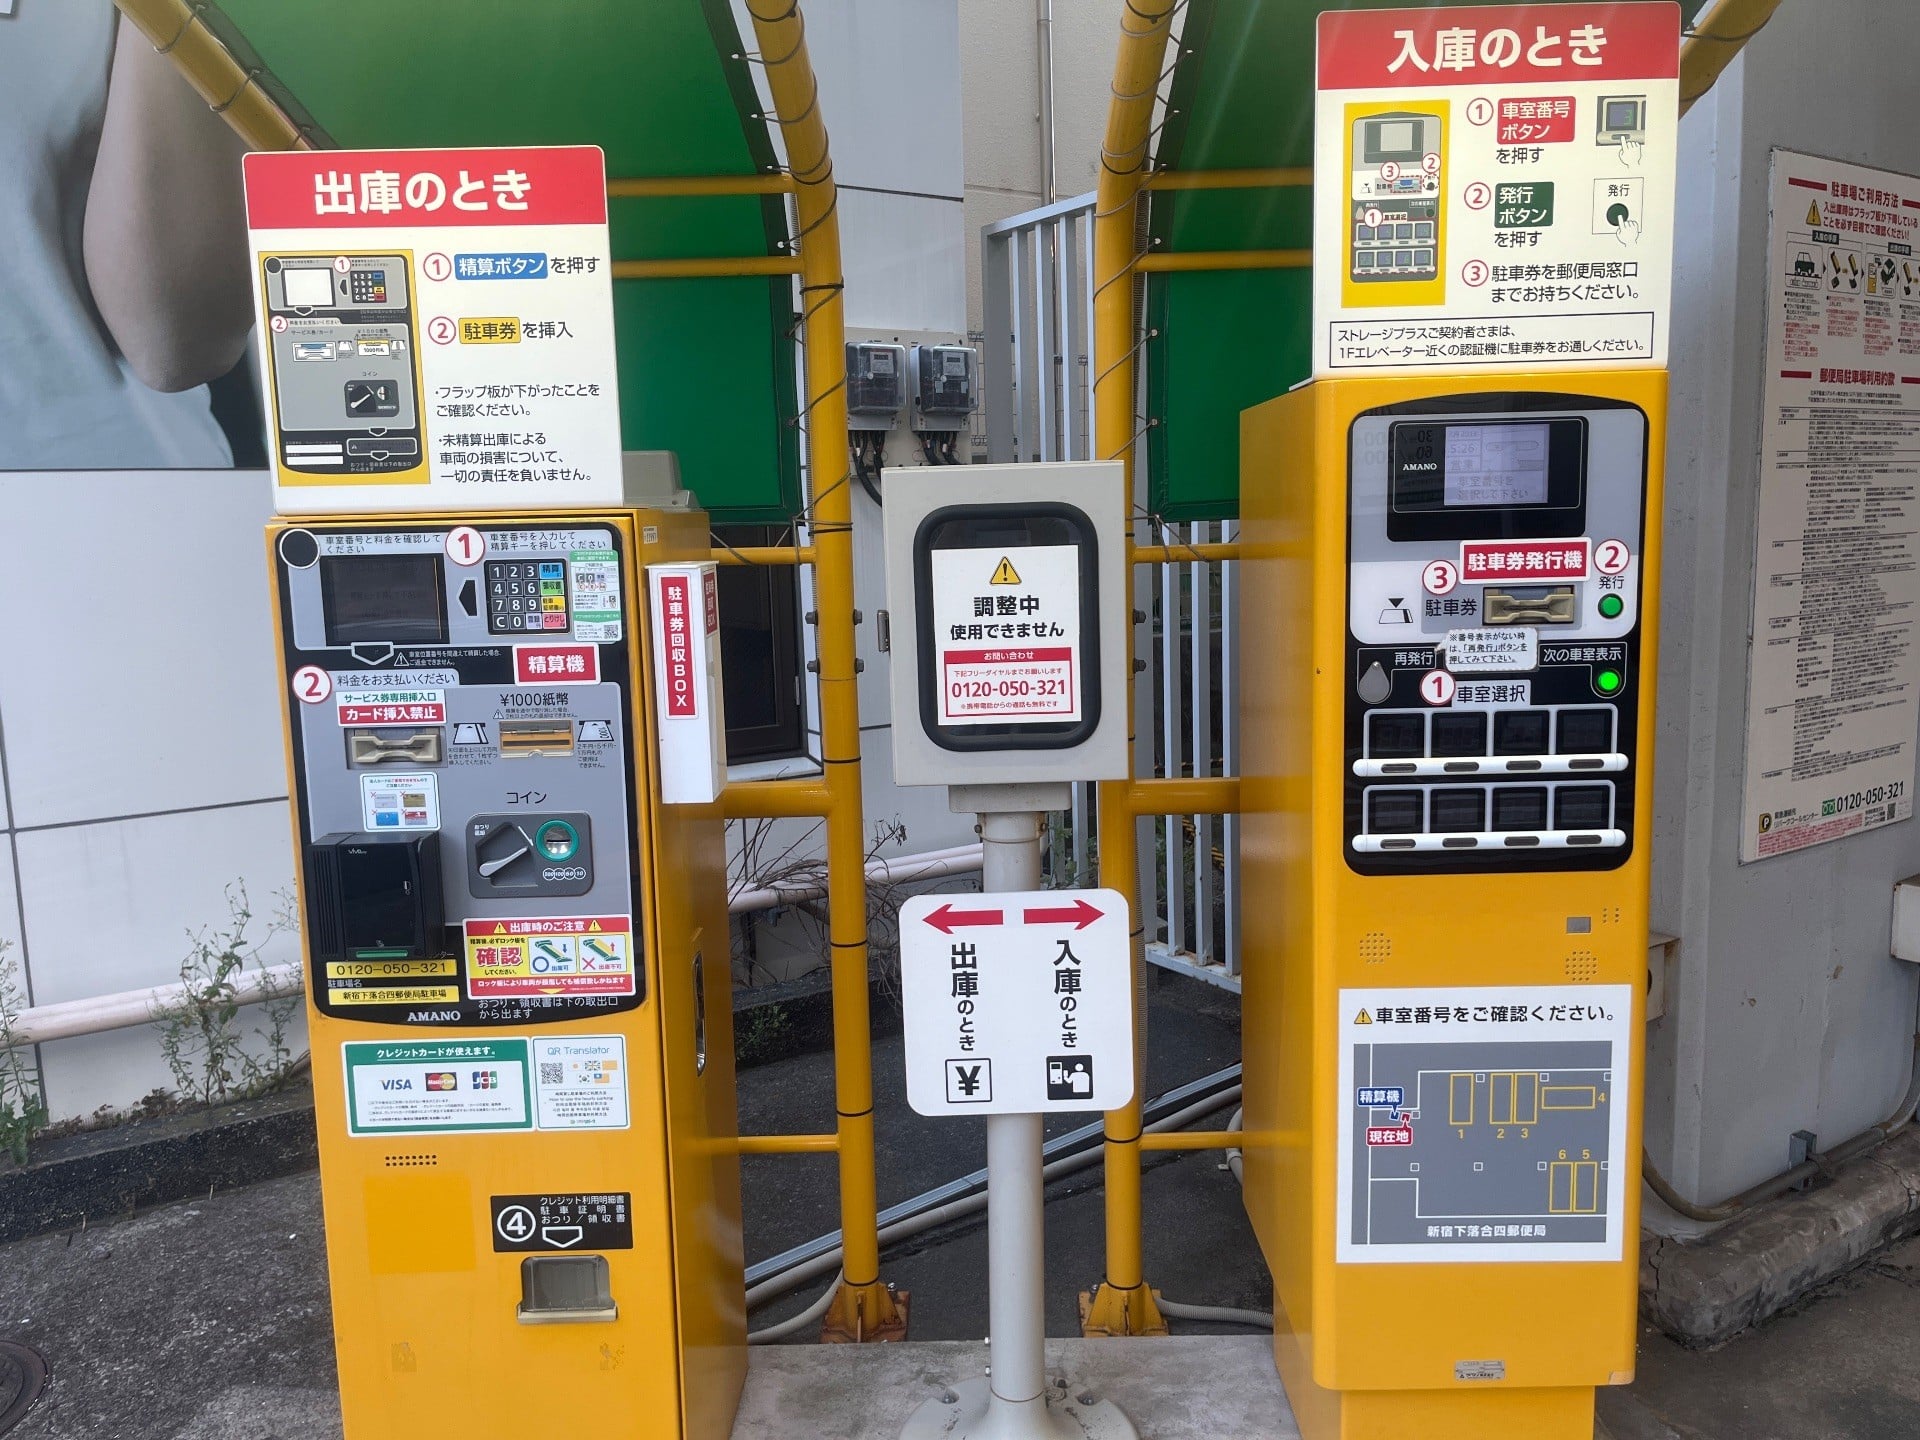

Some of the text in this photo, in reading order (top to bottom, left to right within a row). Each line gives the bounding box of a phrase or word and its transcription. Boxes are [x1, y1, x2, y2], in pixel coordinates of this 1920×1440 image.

[1386, 25, 1608, 74] 入庫のとき
[1501, 100, 1570, 119] 車室番号
[1501, 123, 1550, 140] ボタン
[1495, 147, 1544, 165] を押す
[314, 169, 531, 215] 出庫のとき
[1499, 187, 1534, 205] 発行
[1607, 183, 1631, 197] 発行
[1831, 181, 1899, 208] 駐車場ご利用方法
[1499, 207, 1547, 225] ボタン
[1493, 231, 1543, 248] を押す
[459, 255, 545, 276] 精算ボタン
[550, 256, 600, 274] を押す
[1491, 262, 1639, 282] 駐車券を郵便局窓口
[1491, 284, 1639, 303] までお持ちください。
[464, 321, 517, 341] 駐車券
[522, 321, 574, 339] を挿入
[1338, 325, 1516, 342] ストレージプラスご契約者さまは、
[1339, 341, 1645, 359] 1Fエレベーター近くの認証機に駐車券をお通しください。
[436, 403, 532, 418] ご確認ください。
[440, 451, 564, 465] 車両の損害について、
[1403, 463, 1437, 471] AMANO
[440, 468, 593, 484] 一切の責任を負いません。
[325, 534, 441, 545] 車室番号と料金を確認して
[490, 531, 576, 542] 車室番号を入力して
[326, 545, 365, 554] ください
[490, 541, 606, 550] 精算キーを押してください
[1468, 551, 1582, 571] 駐車券発行機
[493, 566, 500, 578] 1
[510, 566, 518, 577] 2
[527, 566, 535, 577] 3
[494, 584, 503, 595] 4
[511, 583, 519, 594] 5
[527, 582, 536, 593] 6
[1599, 576, 1624, 590] 発行
[495, 600, 503, 611] 7
[512, 600, 520, 610] 8
[528, 599, 537, 610] 9
[973, 594, 1040, 618] 調整中
[1426, 599, 1477, 617] 駐車券
[496, 617, 505, 627] C
[513, 617, 521, 627] 0
[544, 614, 565, 623] とりけし
[950, 622, 1065, 640] 使用できません
[1450, 632, 1526, 642] ※番号表示がない時
[984, 651, 1034, 661] お問い合わせ
[1395, 652, 1434, 666] 再発行
[1449, 654, 1517, 664] 押してみて下さい。
[1543, 648, 1622, 662] 次の車室表示
[527, 654, 585, 675] 精算機
[337, 672, 456, 687] 料金をお支払いください
[954, 667, 1062, 678] 下記フリーダイヤルまでお願いします
[952, 679, 1066, 698] 0120-050-321
[1457, 686, 1525, 702] 車室選択
[344, 692, 437, 704] サービス券専用挿入口
[346, 706, 437, 722] カード挿入禁止
[506, 791, 547, 804] コイン
[1837, 781, 1904, 812] 0120-050-321
[510, 920, 585, 933] 出庫時のご注意
[476, 946, 522, 967] 確認
[336, 962, 446, 976] 0120-050-321
[327, 979, 363, 988] 駐車場名
[343, 990, 448, 1000] 新宿下落合四郵便局駐車場
[951, 942, 979, 1052] 出庫のとき
[1053, 940, 1082, 1048] 入庫のとき
[407, 1010, 461, 1022] AMANO
[479, 1009, 533, 1020] から出ます
[1376, 1005, 1614, 1024] 車室番号をご確認ください。
[377, 1046, 496, 1058] クレジットカードが使えます。
[547, 1045, 610, 1055] QR Translator
[380, 1079, 413, 1091] VISA
[472, 1076, 497, 1085] JCB
[1360, 1090, 1400, 1103] 精算機
[1598, 1092, 1606, 1102] 4
[1369, 1130, 1409, 1143] 現在地
[1458, 1128, 1529, 1139] 1 2 3
[1559, 1149, 1590, 1160] 6 5
[540, 1196, 625, 1205] クレジット利用明細書
[1427, 1225, 1546, 1238] 新宿下落合四郵便局
